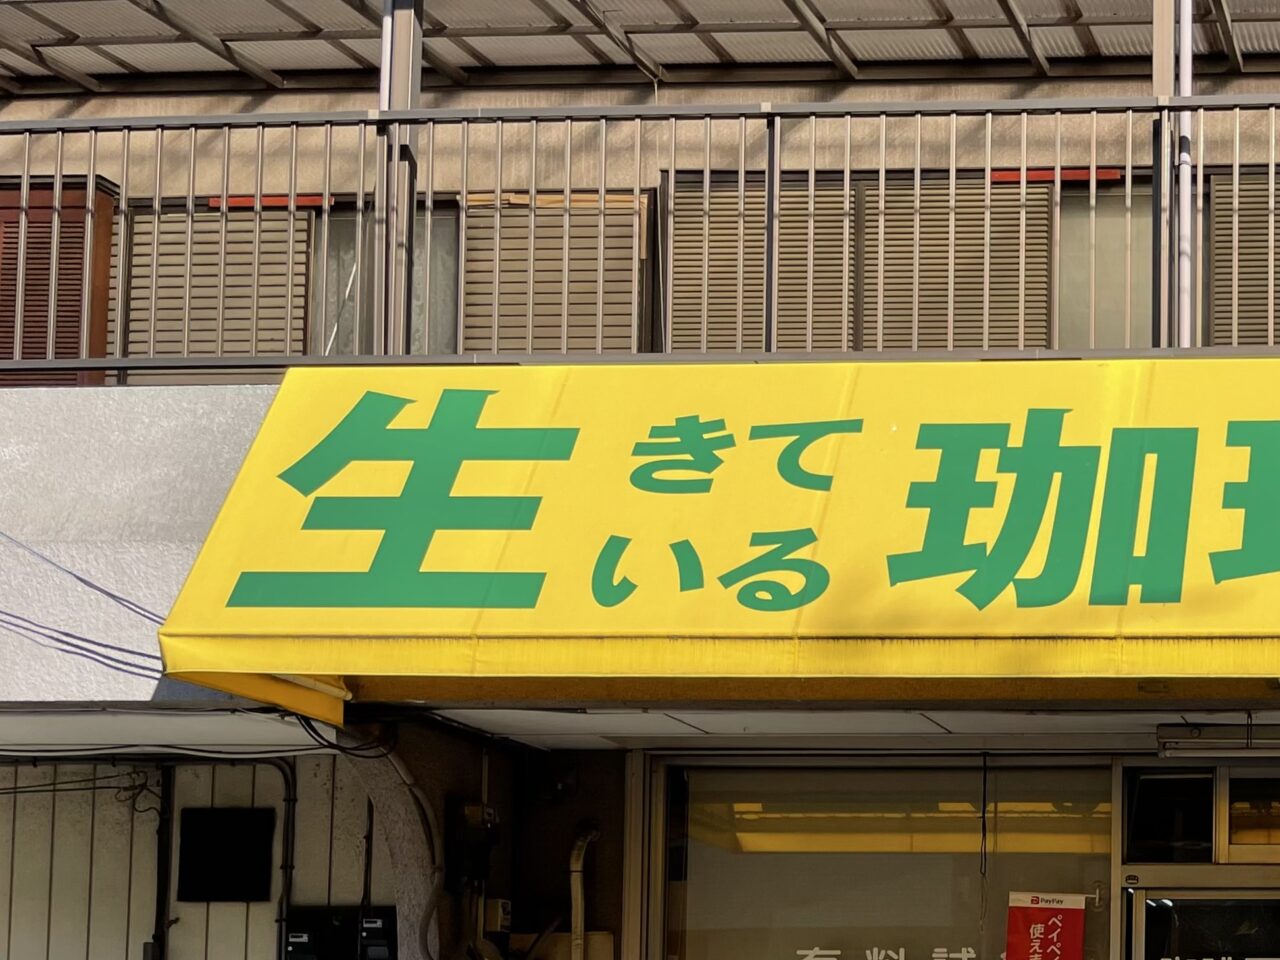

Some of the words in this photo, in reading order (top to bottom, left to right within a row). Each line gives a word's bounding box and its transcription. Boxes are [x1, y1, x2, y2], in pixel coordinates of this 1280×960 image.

[630, 414, 862, 493] きて
[228, 389, 578, 608] 生
[592, 529, 830, 611] いる
